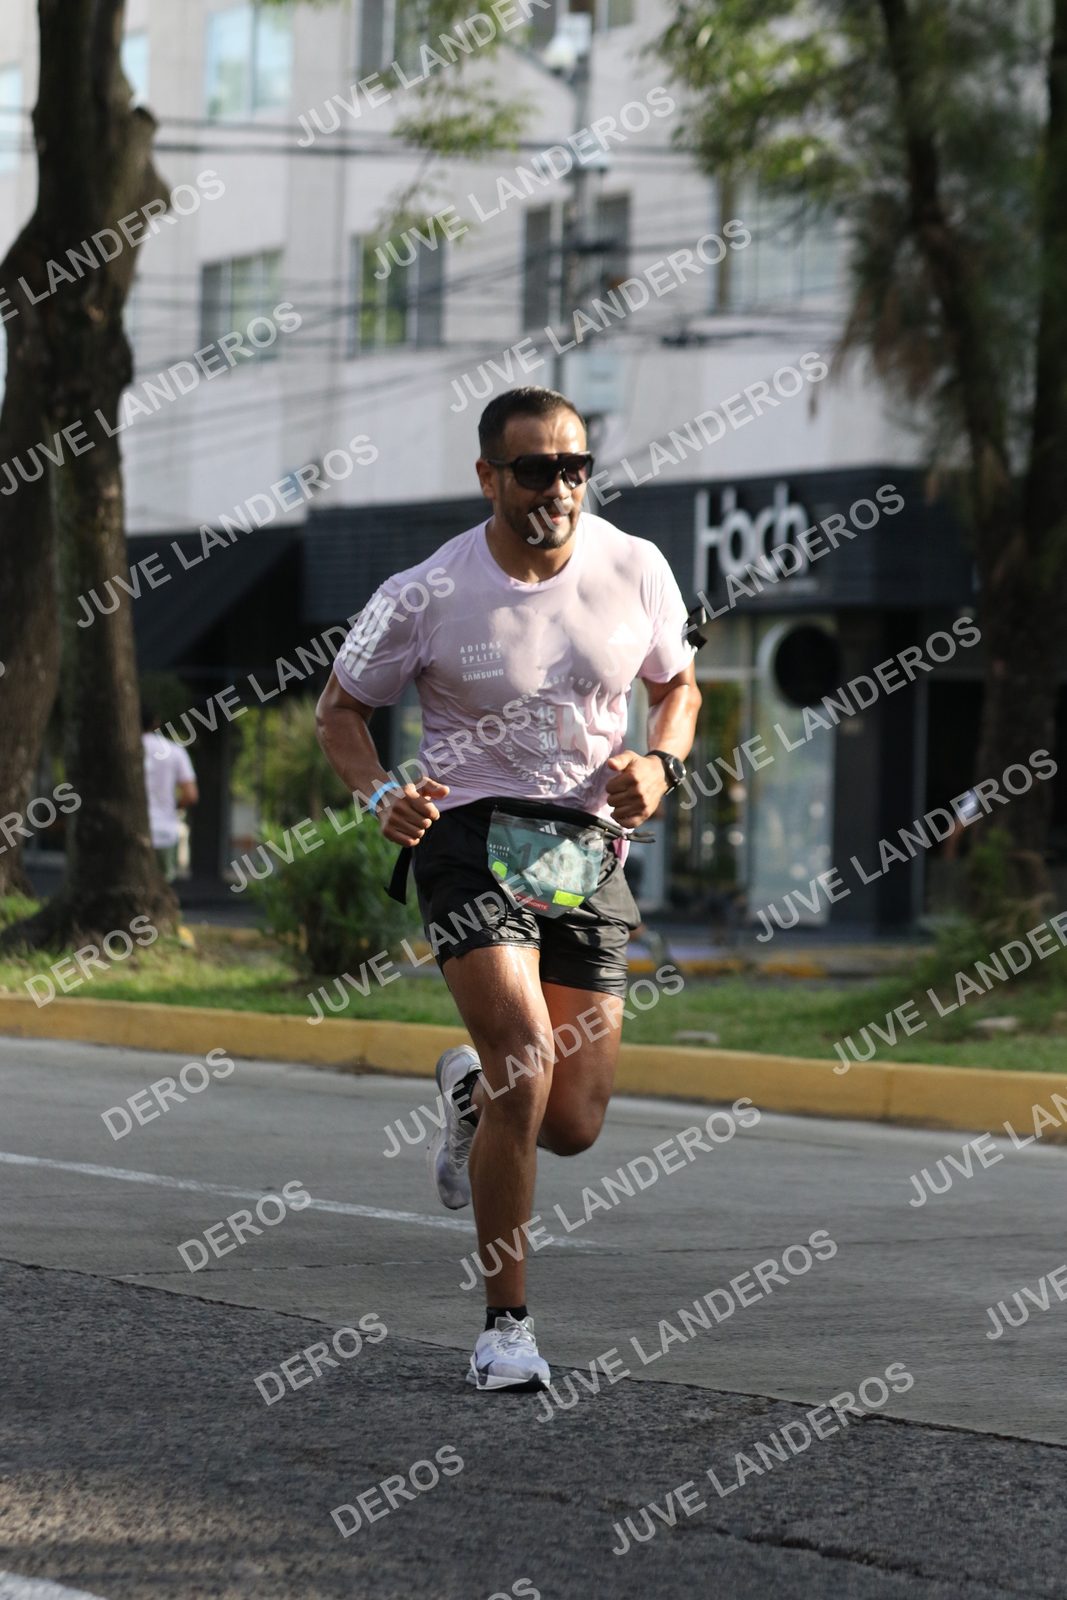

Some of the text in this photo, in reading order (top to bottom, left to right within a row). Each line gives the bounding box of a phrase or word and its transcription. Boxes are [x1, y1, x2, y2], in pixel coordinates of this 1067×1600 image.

[460, 641, 501, 654] ADIDAS
[461, 652, 501, 665] SPLITS
[462, 668, 504, 682] SAMSUNG
[539, 730, 558, 750] 30
